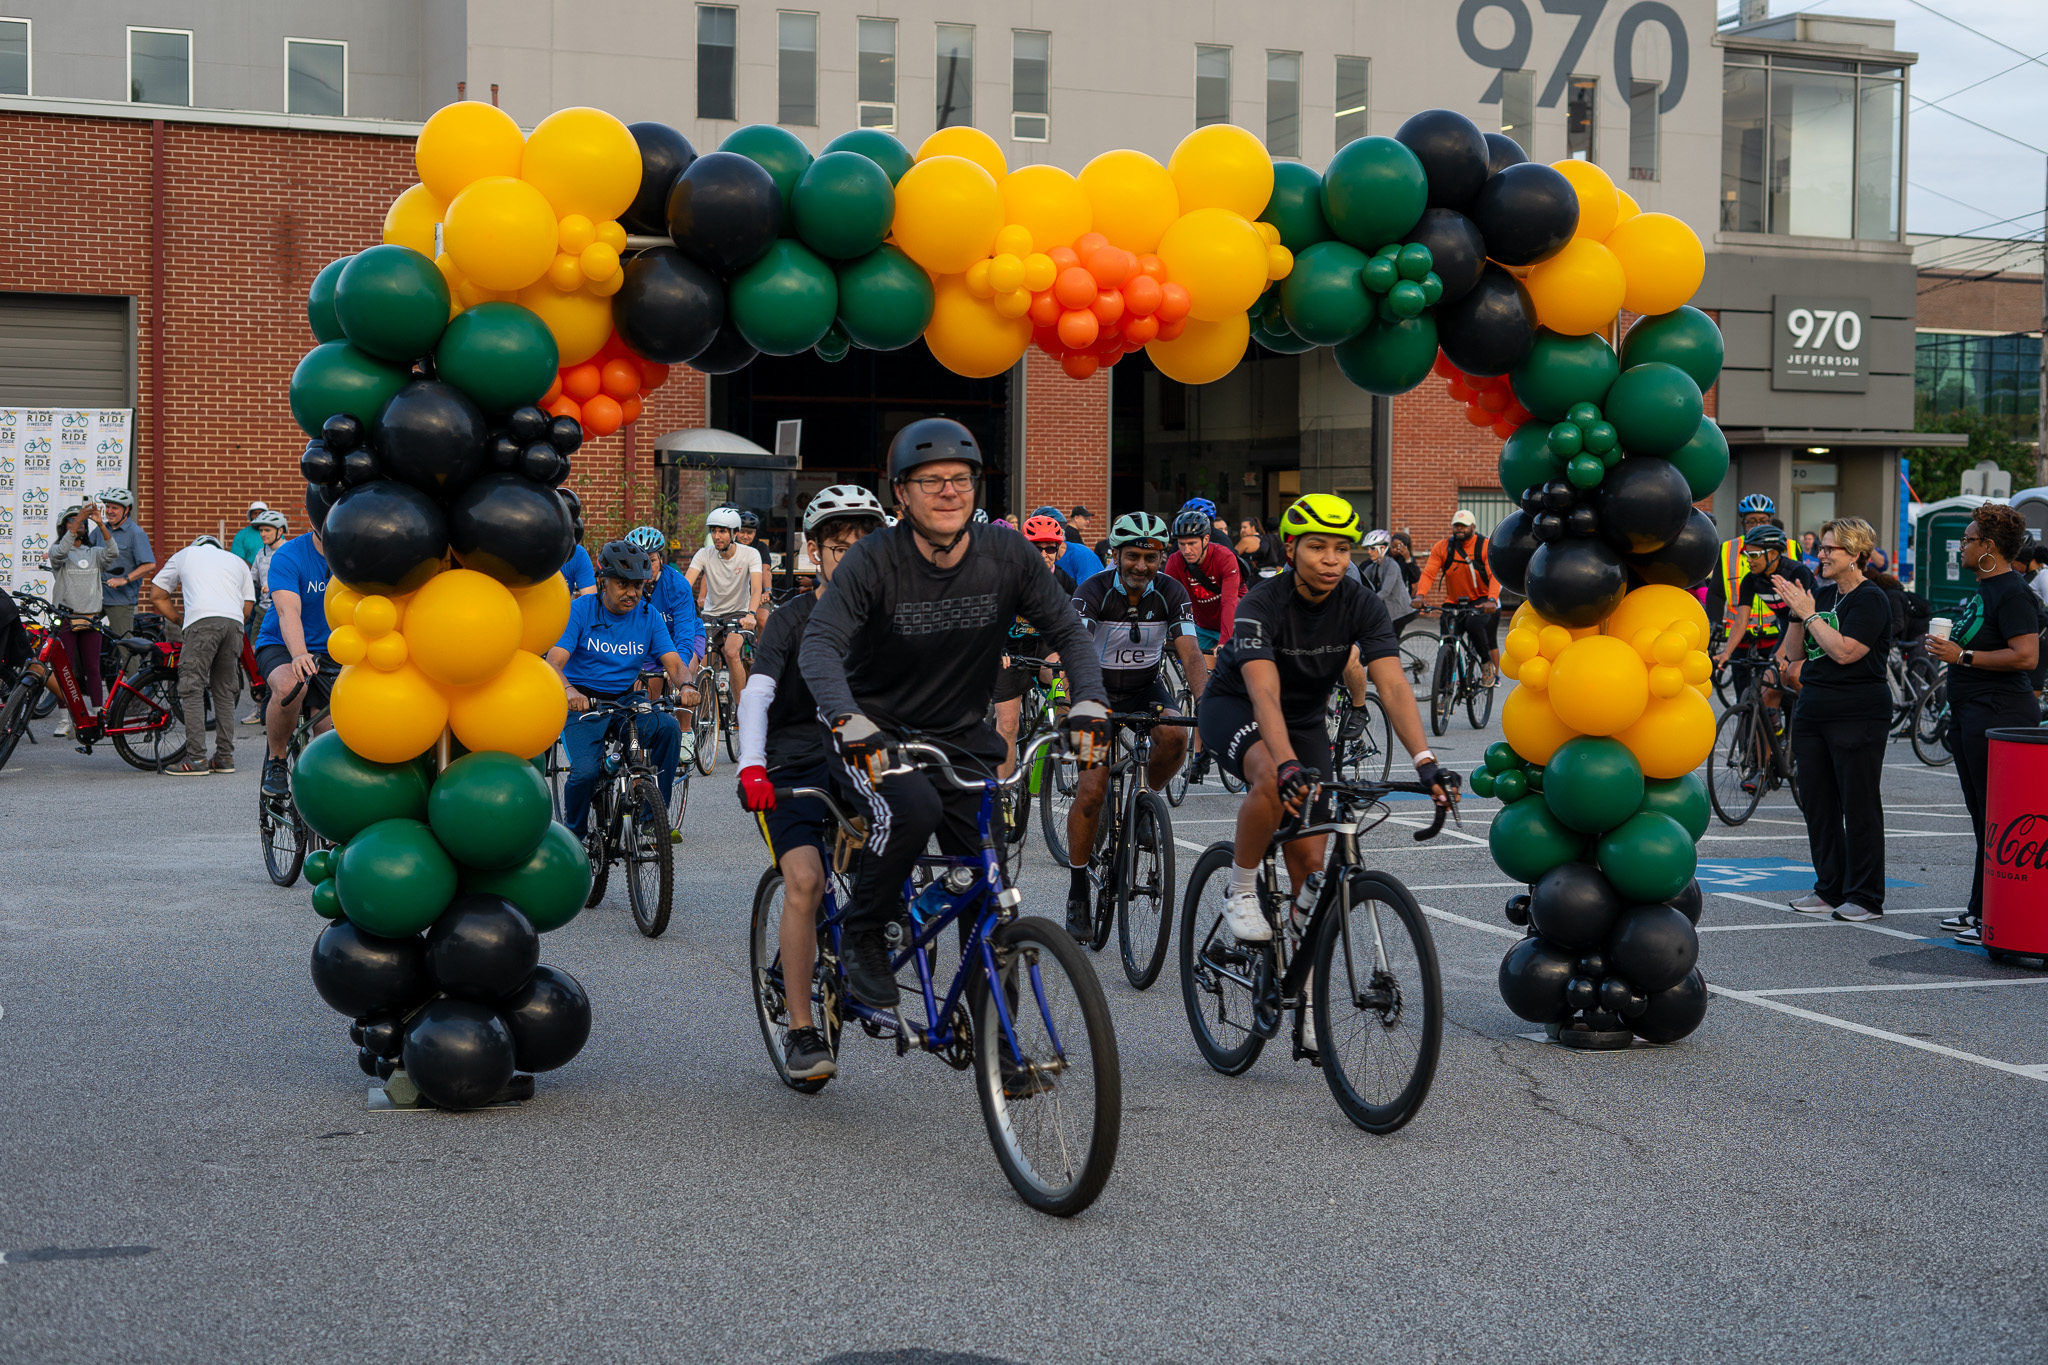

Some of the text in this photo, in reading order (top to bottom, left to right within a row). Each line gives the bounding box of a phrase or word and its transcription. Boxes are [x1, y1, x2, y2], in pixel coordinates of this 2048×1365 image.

[1456, 0, 1689, 114] 970
[1787, 308, 1861, 351] 970
[1787, 355, 1859, 366] JEFFERSON
[1792, 469, 1807, 479] 70
[23, 508, 48, 516] RIDE
[306, 580, 327, 594] No
[586, 637, 645, 655] Novelis
[62, 665, 80, 703] VELOTRIC
[1227, 721, 1259, 760] RAPHA
[1996, 871, 2028, 882] SUGAR
[1983, 924, 1995, 941] TS
